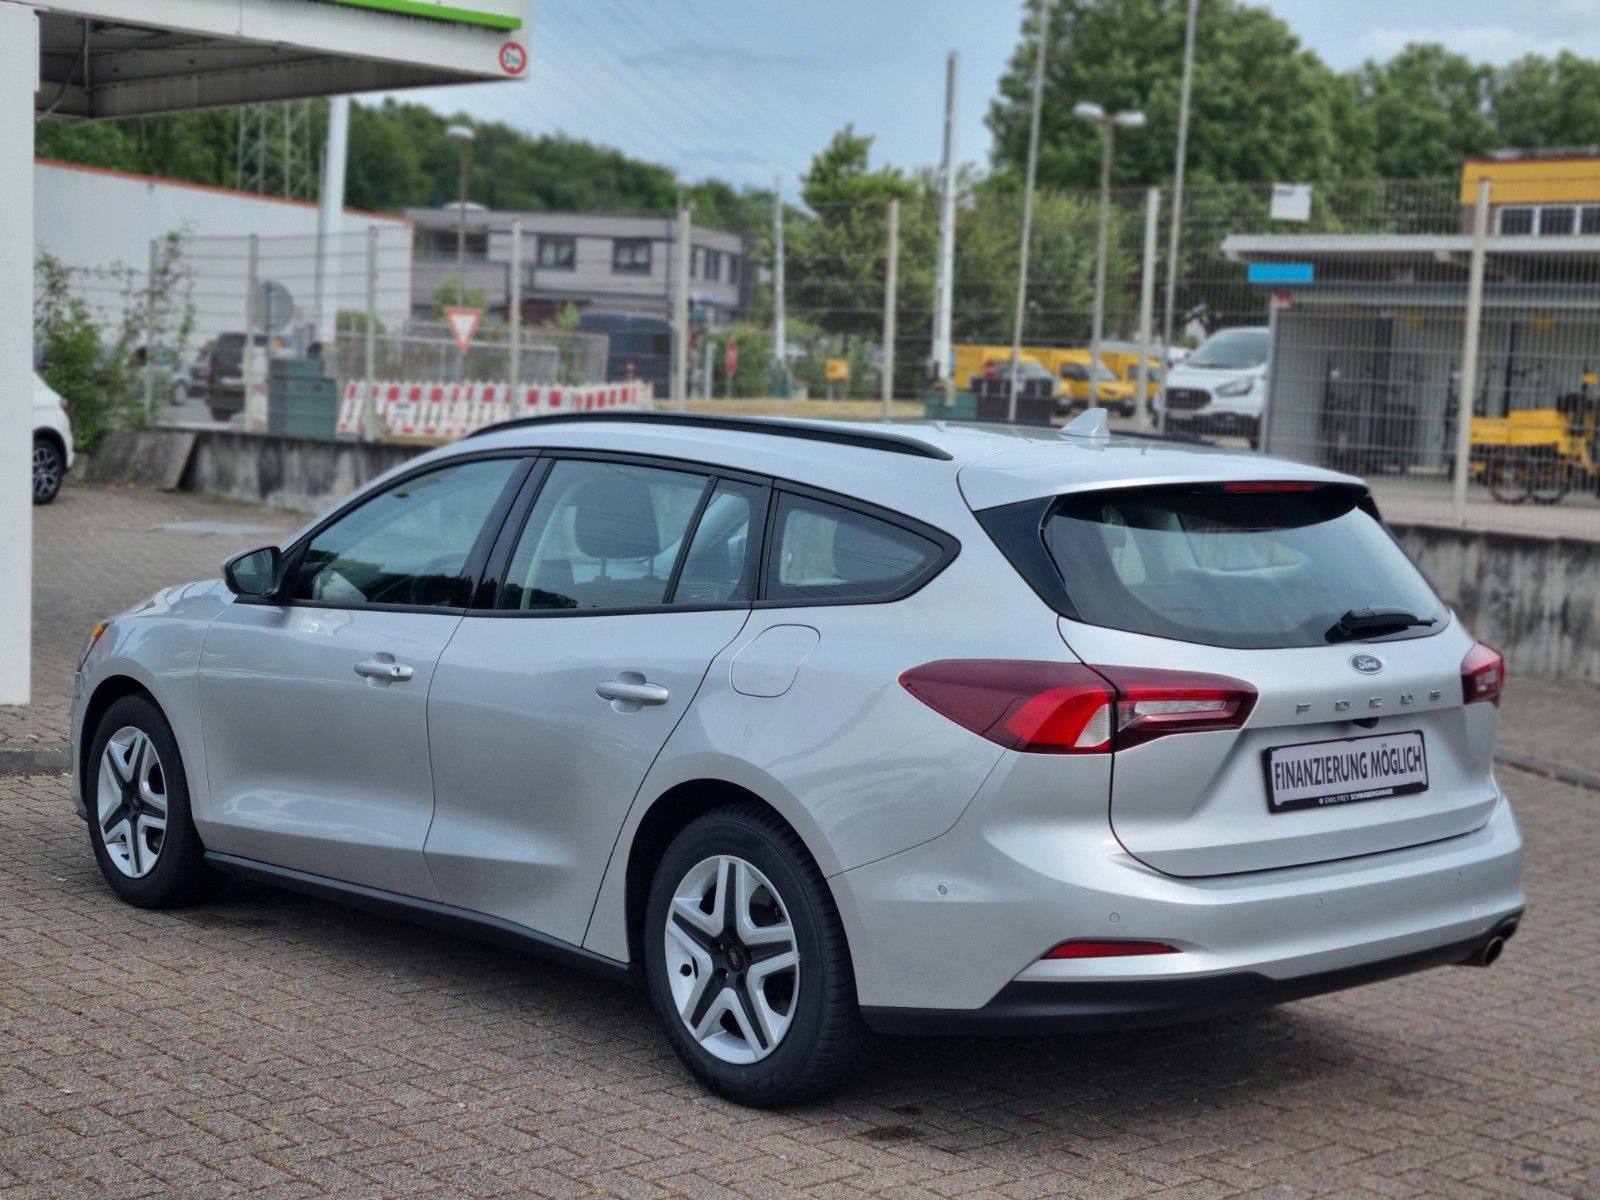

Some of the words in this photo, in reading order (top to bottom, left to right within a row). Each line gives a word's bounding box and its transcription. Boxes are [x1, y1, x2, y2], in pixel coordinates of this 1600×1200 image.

[1296, 689, 1441, 716] FOCUS
[1275, 751, 1368, 790] FINANZIERUNG
[1371, 743, 1422, 778] MÖGLICH
